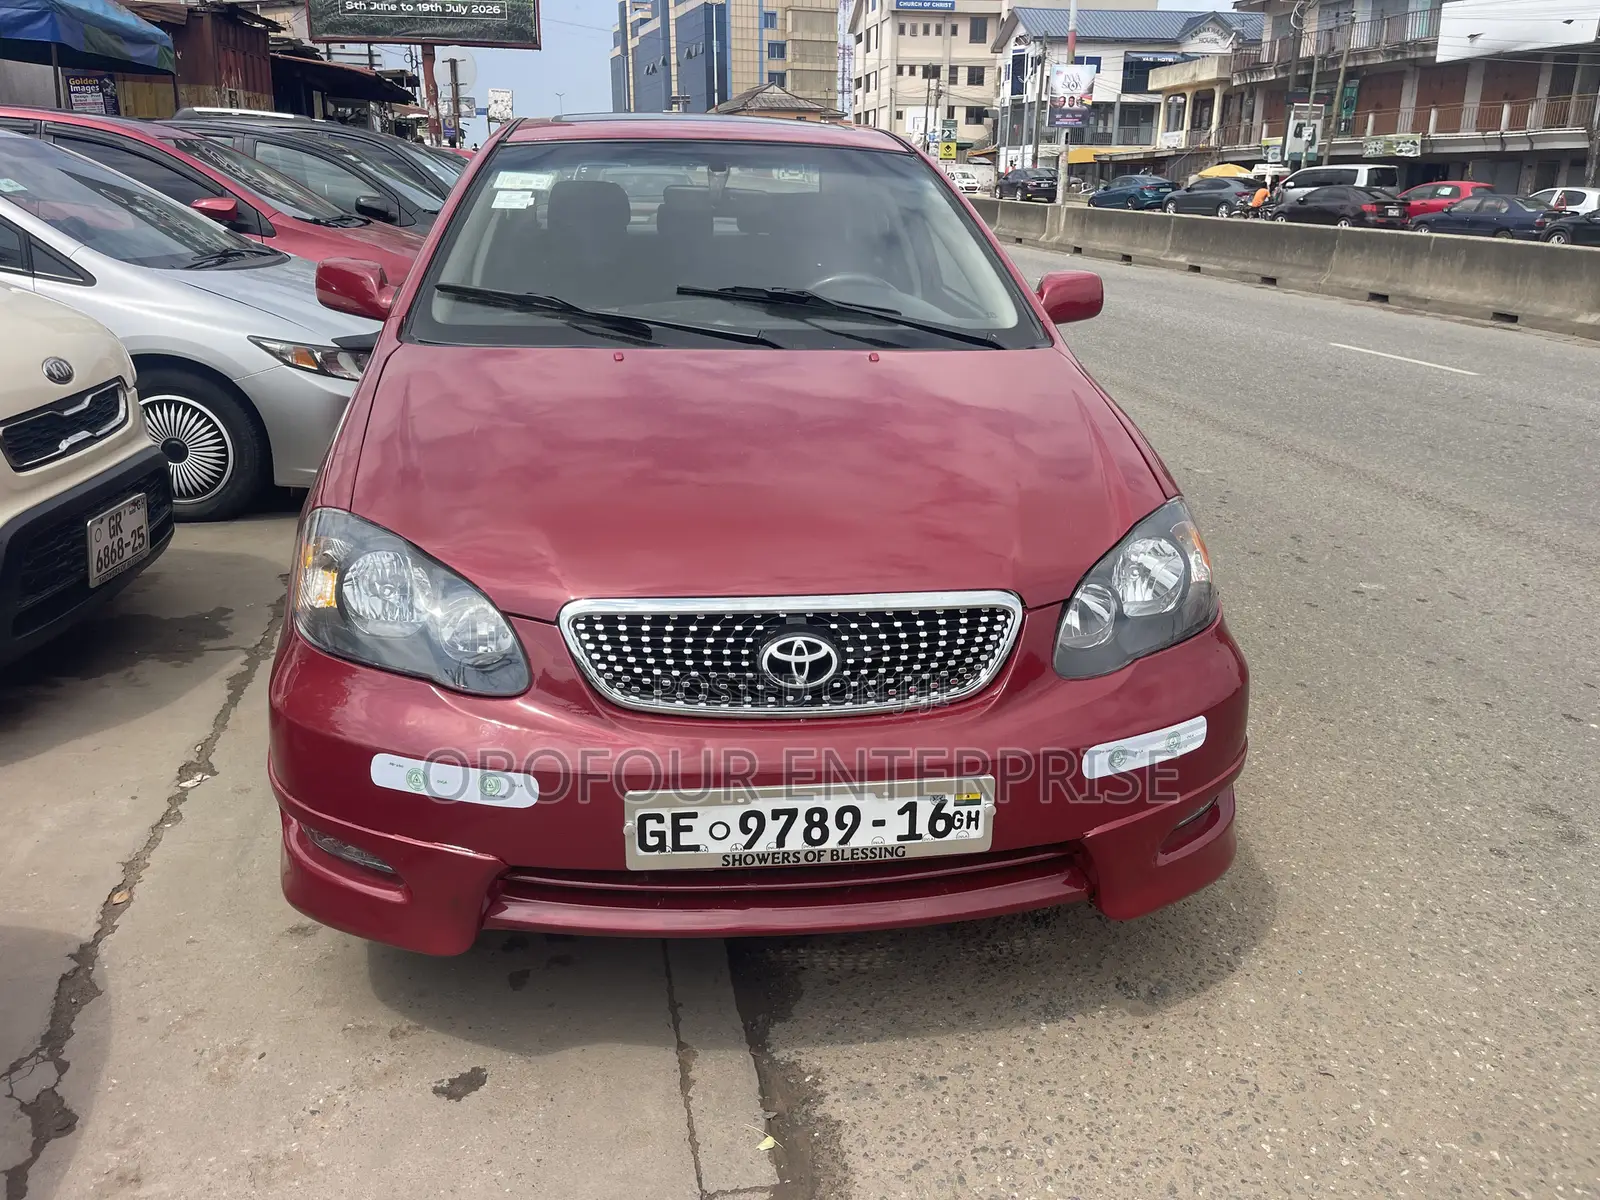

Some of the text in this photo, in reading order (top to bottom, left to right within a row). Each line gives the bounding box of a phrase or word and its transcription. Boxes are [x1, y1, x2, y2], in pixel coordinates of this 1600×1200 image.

[370, 1, 397, 11] June
[400, 3, 414, 11] to
[417, 3, 442, 12] 19th
[445, 3, 468, 15] July
[471, 5, 501, 14] 2026
[70, 85, 100, 94] Images
[49, 362, 73, 380] KIA
[108, 511, 123, 540] GR
[96, 525, 145, 573] 6868-25
[637, 798, 979, 853] GE 9789-16 GH
[721, 845, 906, 867] SHOWERS OF BLESSING
